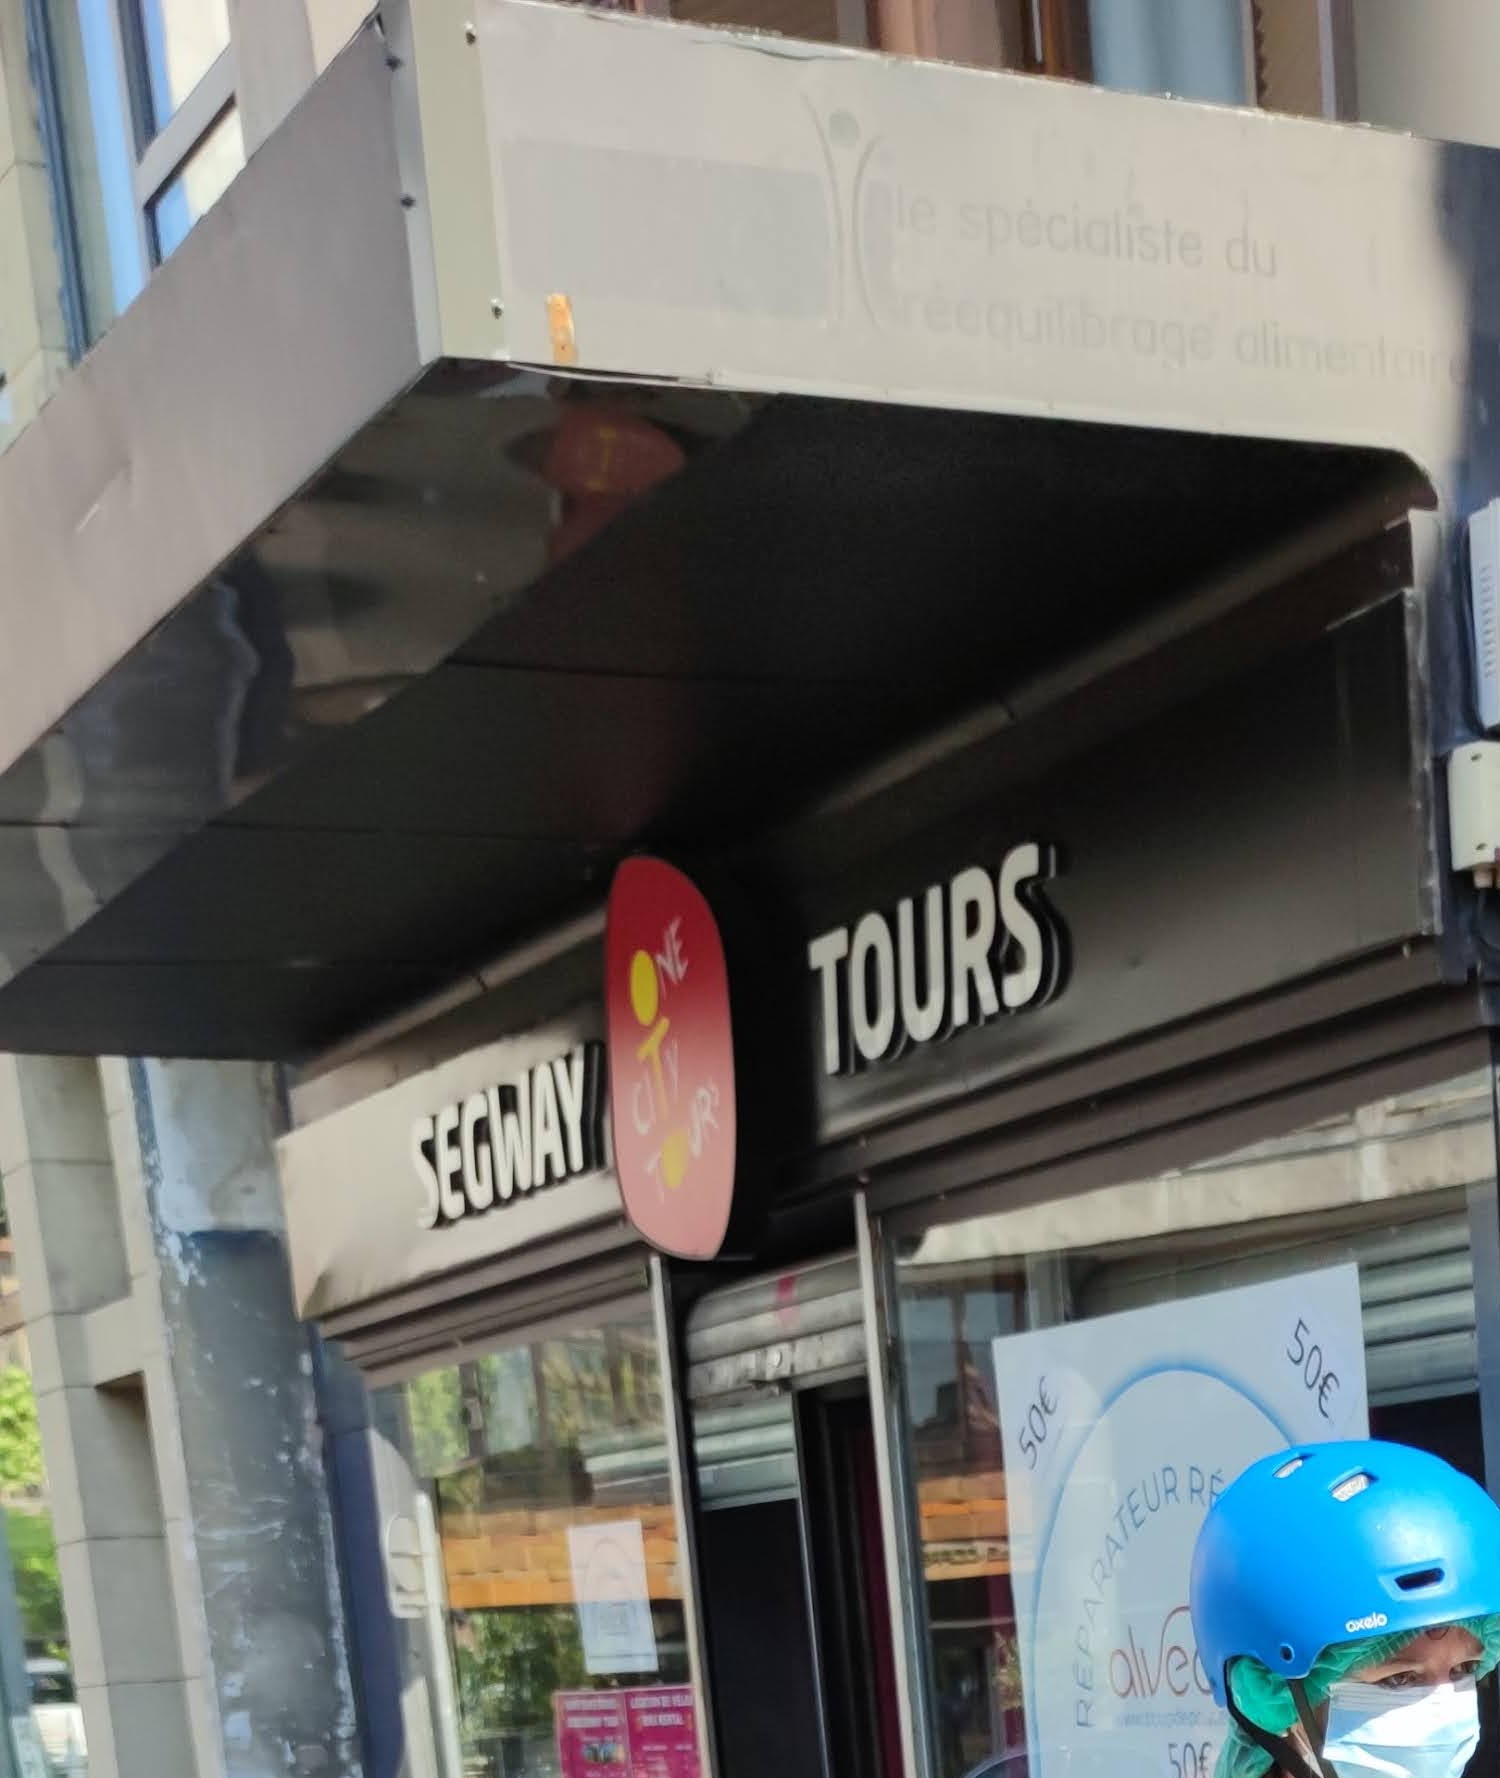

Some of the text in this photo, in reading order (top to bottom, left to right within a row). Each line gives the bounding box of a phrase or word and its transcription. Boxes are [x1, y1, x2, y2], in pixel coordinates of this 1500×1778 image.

[1225, 202, 1279, 280] du
[808, 842, 1054, 1075] TOURS
[410, 1046, 590, 1230] SEGWAY
[1286, 1318, 1341, 1420] 50€
[1017, 1375, 1059, 1471] 50€
[1344, 1611, 1388, 1633] oxelo
